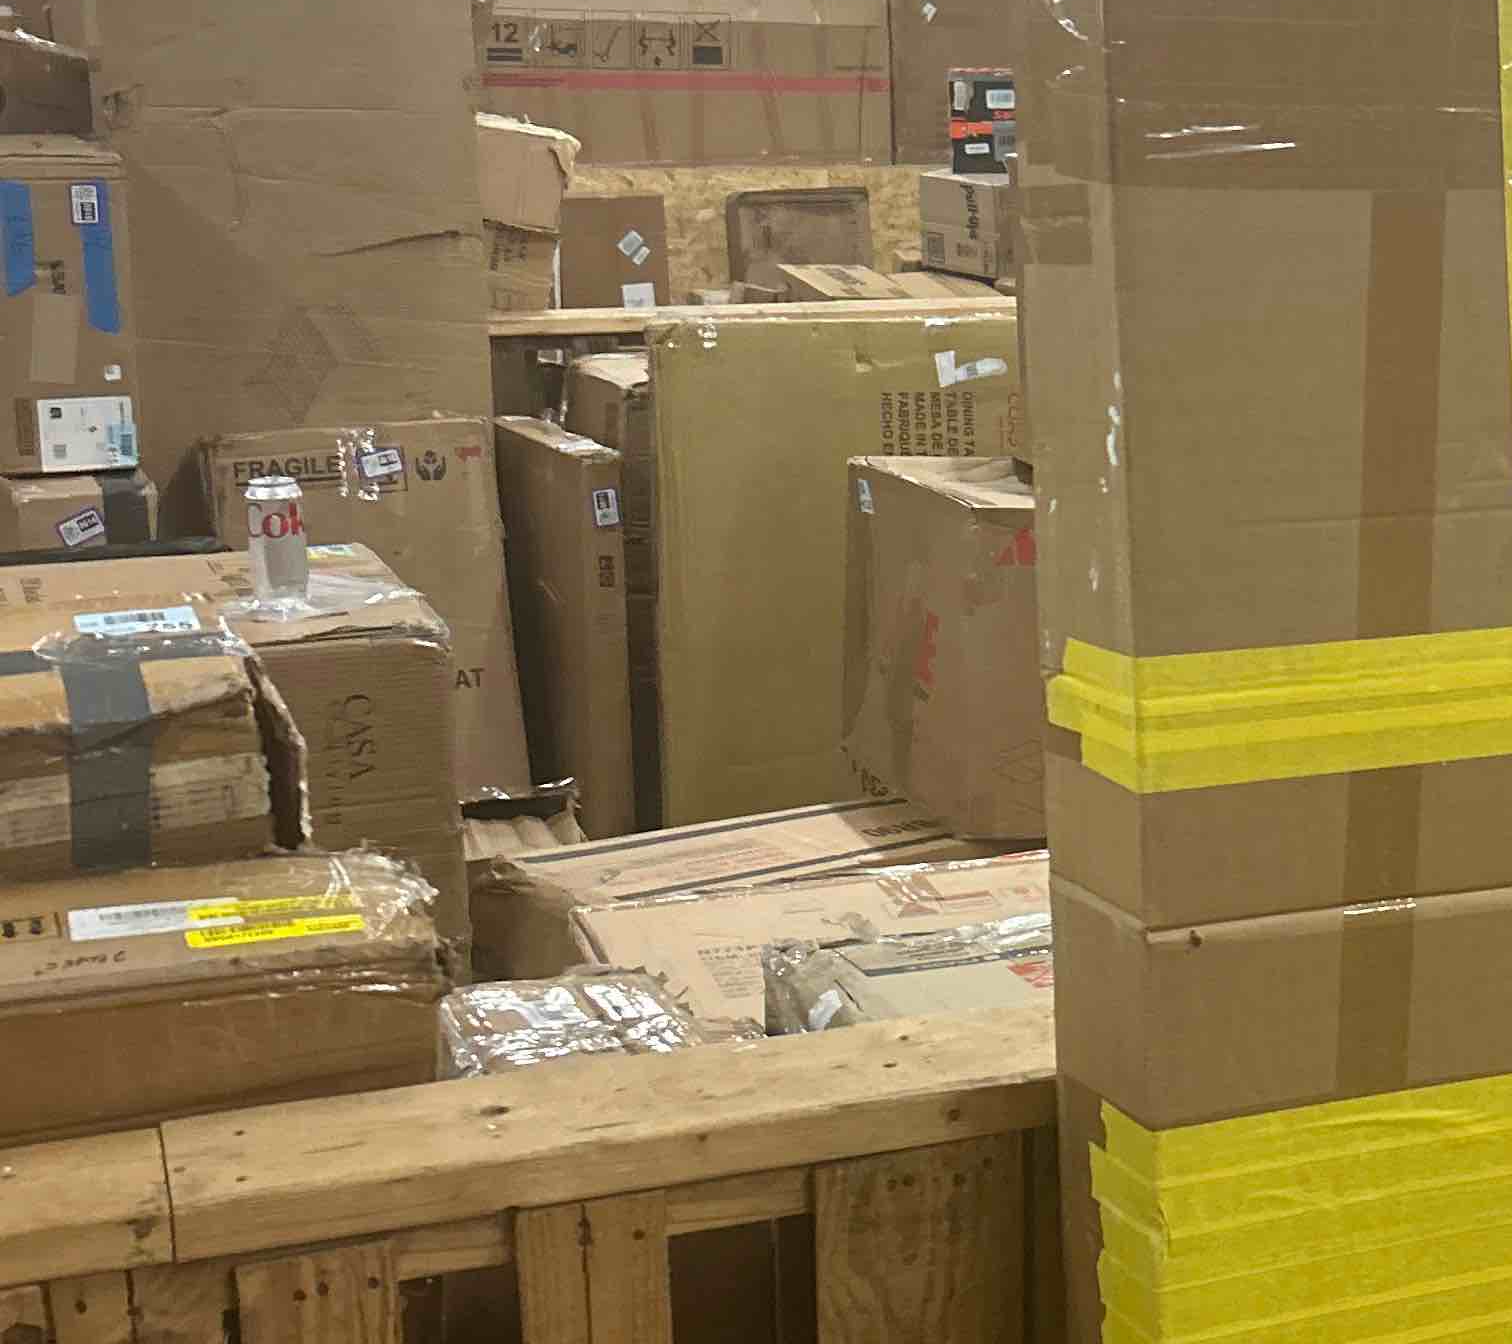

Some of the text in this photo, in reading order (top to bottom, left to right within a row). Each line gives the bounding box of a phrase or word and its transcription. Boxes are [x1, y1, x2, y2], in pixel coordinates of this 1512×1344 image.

[491, 22, 519, 44] 12
[881, 392, 894, 439] HECHO
[914, 392, 927, 430] MADE
[930, 392, 944, 451] MESA DE
[945, 392, 959, 456] TABLE DE
[962, 392, 976, 456] DINING TA
[915, 433, 928, 447] IN
[233, 457, 342, 479] FRAGILE
[248, 502, 304, 539] Cok
[344, 693, 377, 781] CASA
